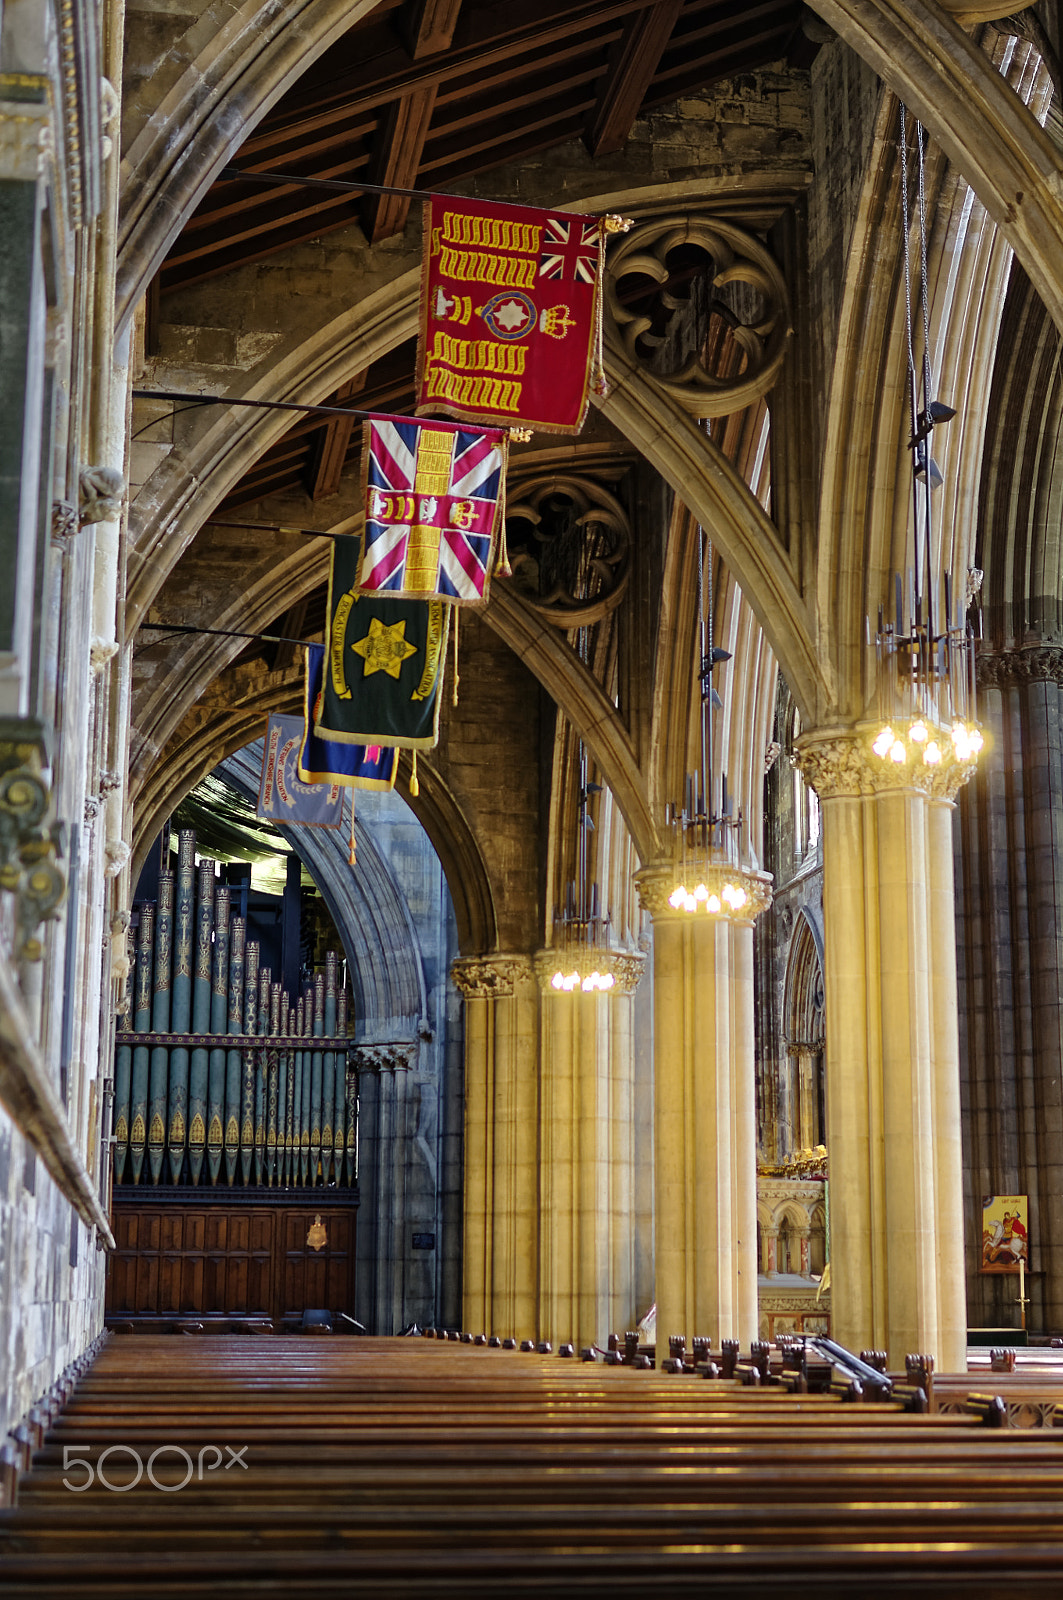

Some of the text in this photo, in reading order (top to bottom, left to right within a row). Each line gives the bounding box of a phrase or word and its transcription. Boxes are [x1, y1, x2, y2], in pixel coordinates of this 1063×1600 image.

[333, 601, 350, 684] DONCASTER BRANCH
[264, 731, 279, 805] SOUTH YORKSHIRE BRANCH
[277, 740, 294, 802] VETERANS ASSOCIATION
